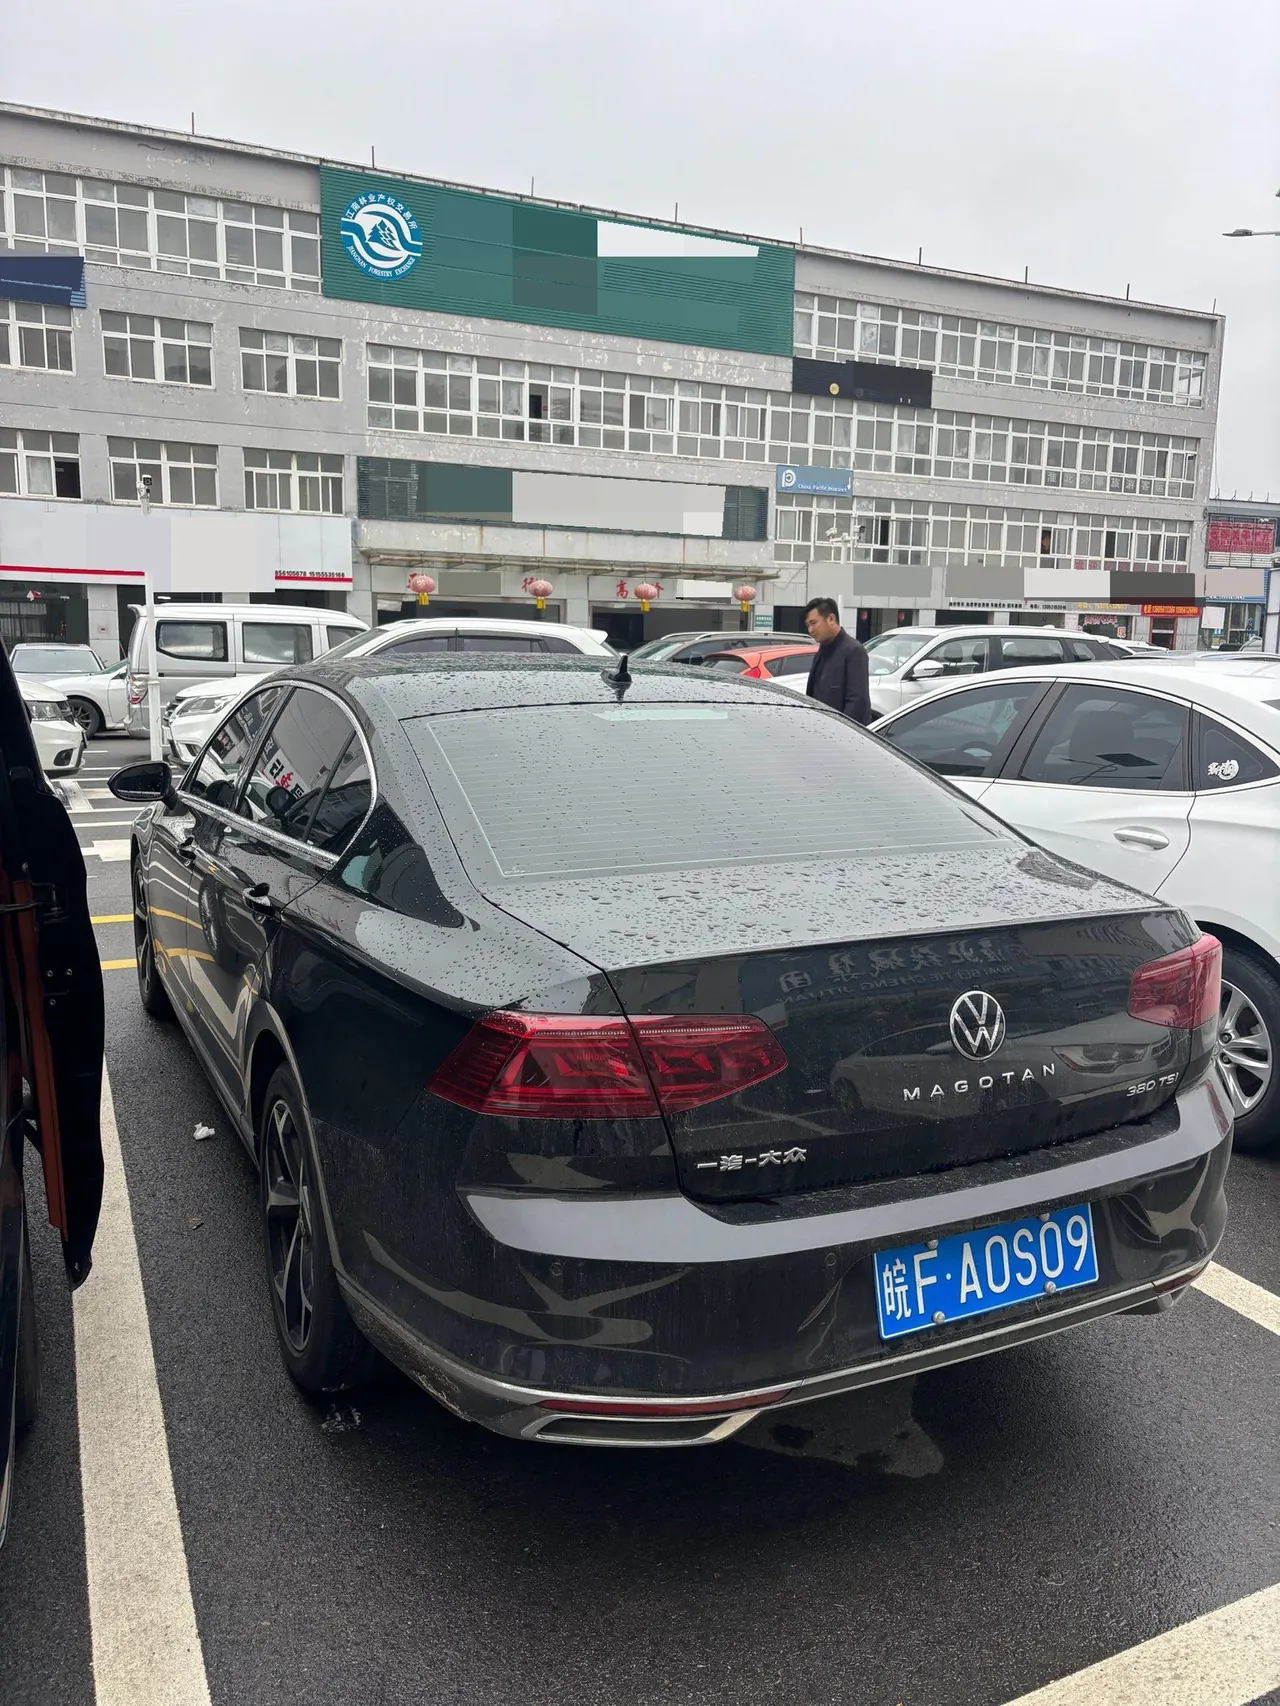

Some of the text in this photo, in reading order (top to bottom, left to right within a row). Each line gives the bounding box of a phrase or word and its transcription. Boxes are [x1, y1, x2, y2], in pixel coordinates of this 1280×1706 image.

[345, 193, 418, 230] 江南林业产权交易所
[368, 266, 393, 277] FORESTRY
[903, 1063, 1055, 1101] MAGOTAN
[1126, 1072, 1180, 1098] 380 TSI
